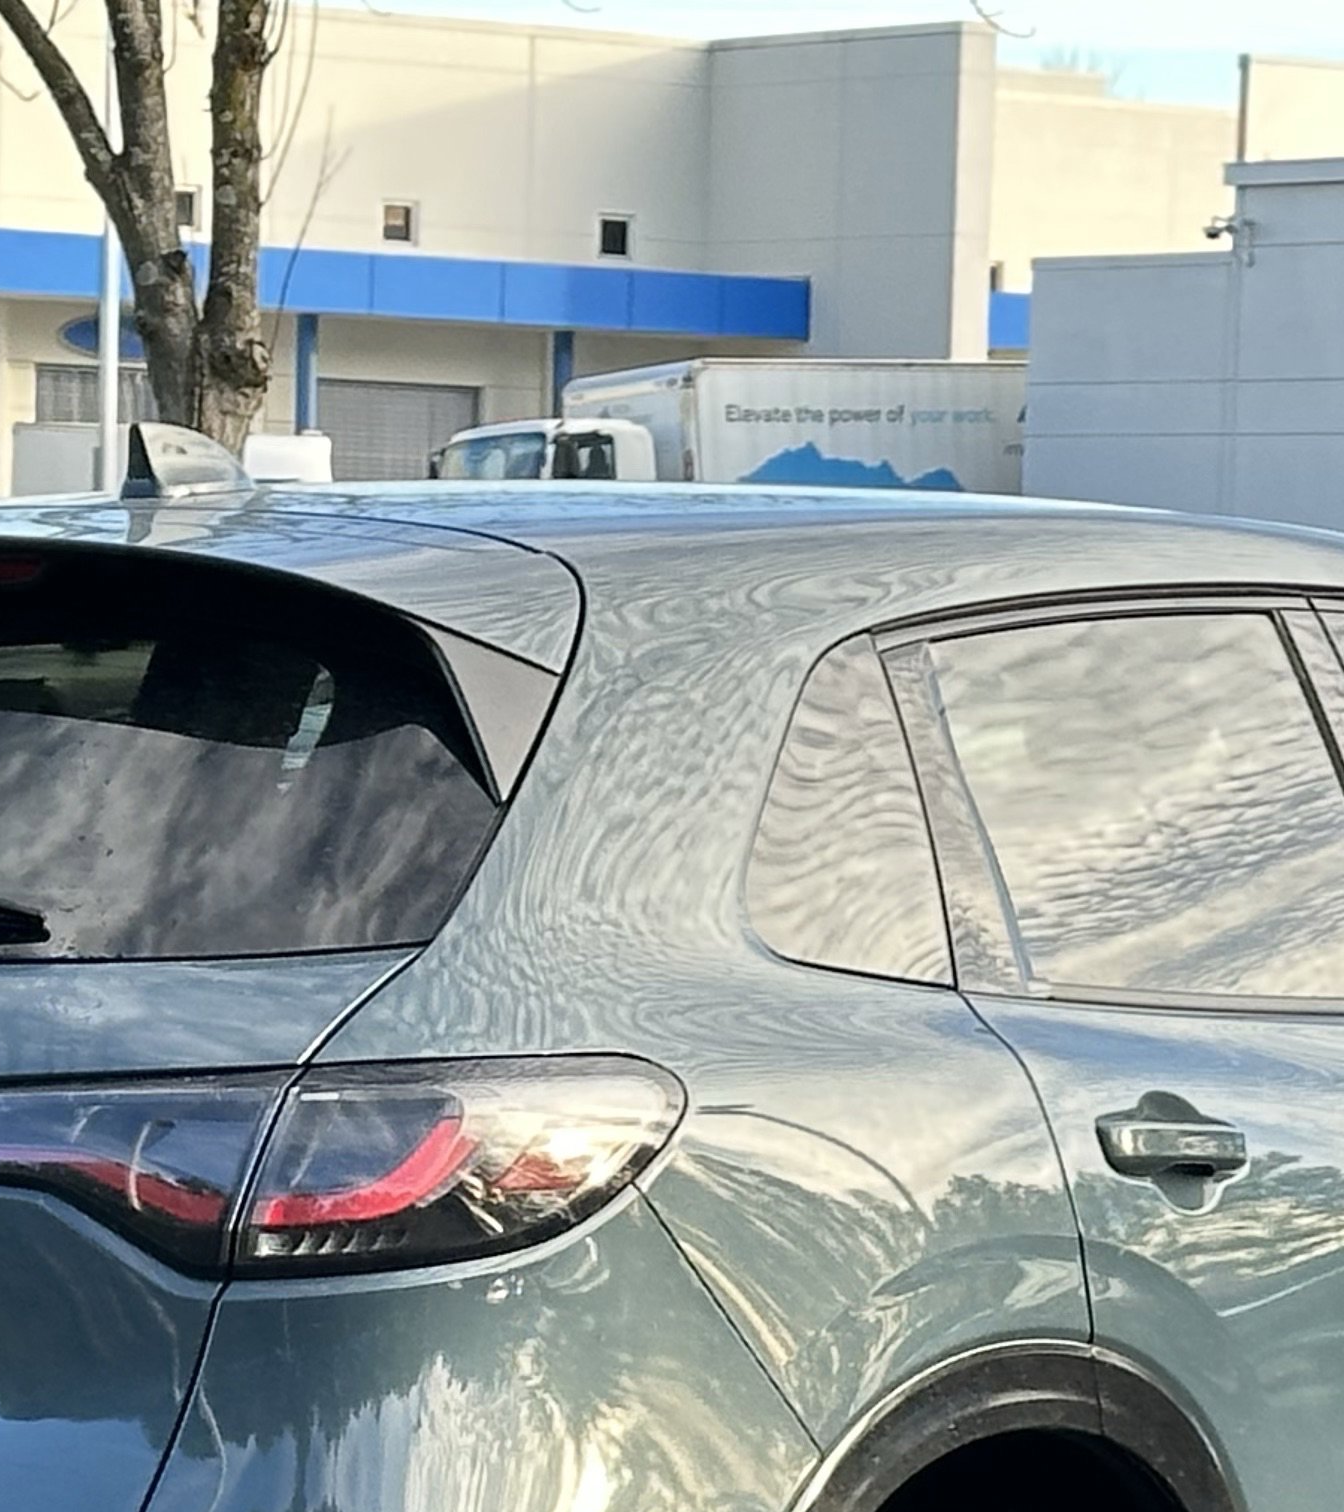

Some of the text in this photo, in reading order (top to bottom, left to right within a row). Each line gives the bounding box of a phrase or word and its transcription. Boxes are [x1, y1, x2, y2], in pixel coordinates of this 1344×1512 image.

[725, 404, 792, 423] Elevate
[794, 404, 824, 423] the
[828, 408, 881, 427] power
[886, 404, 905, 423] of
